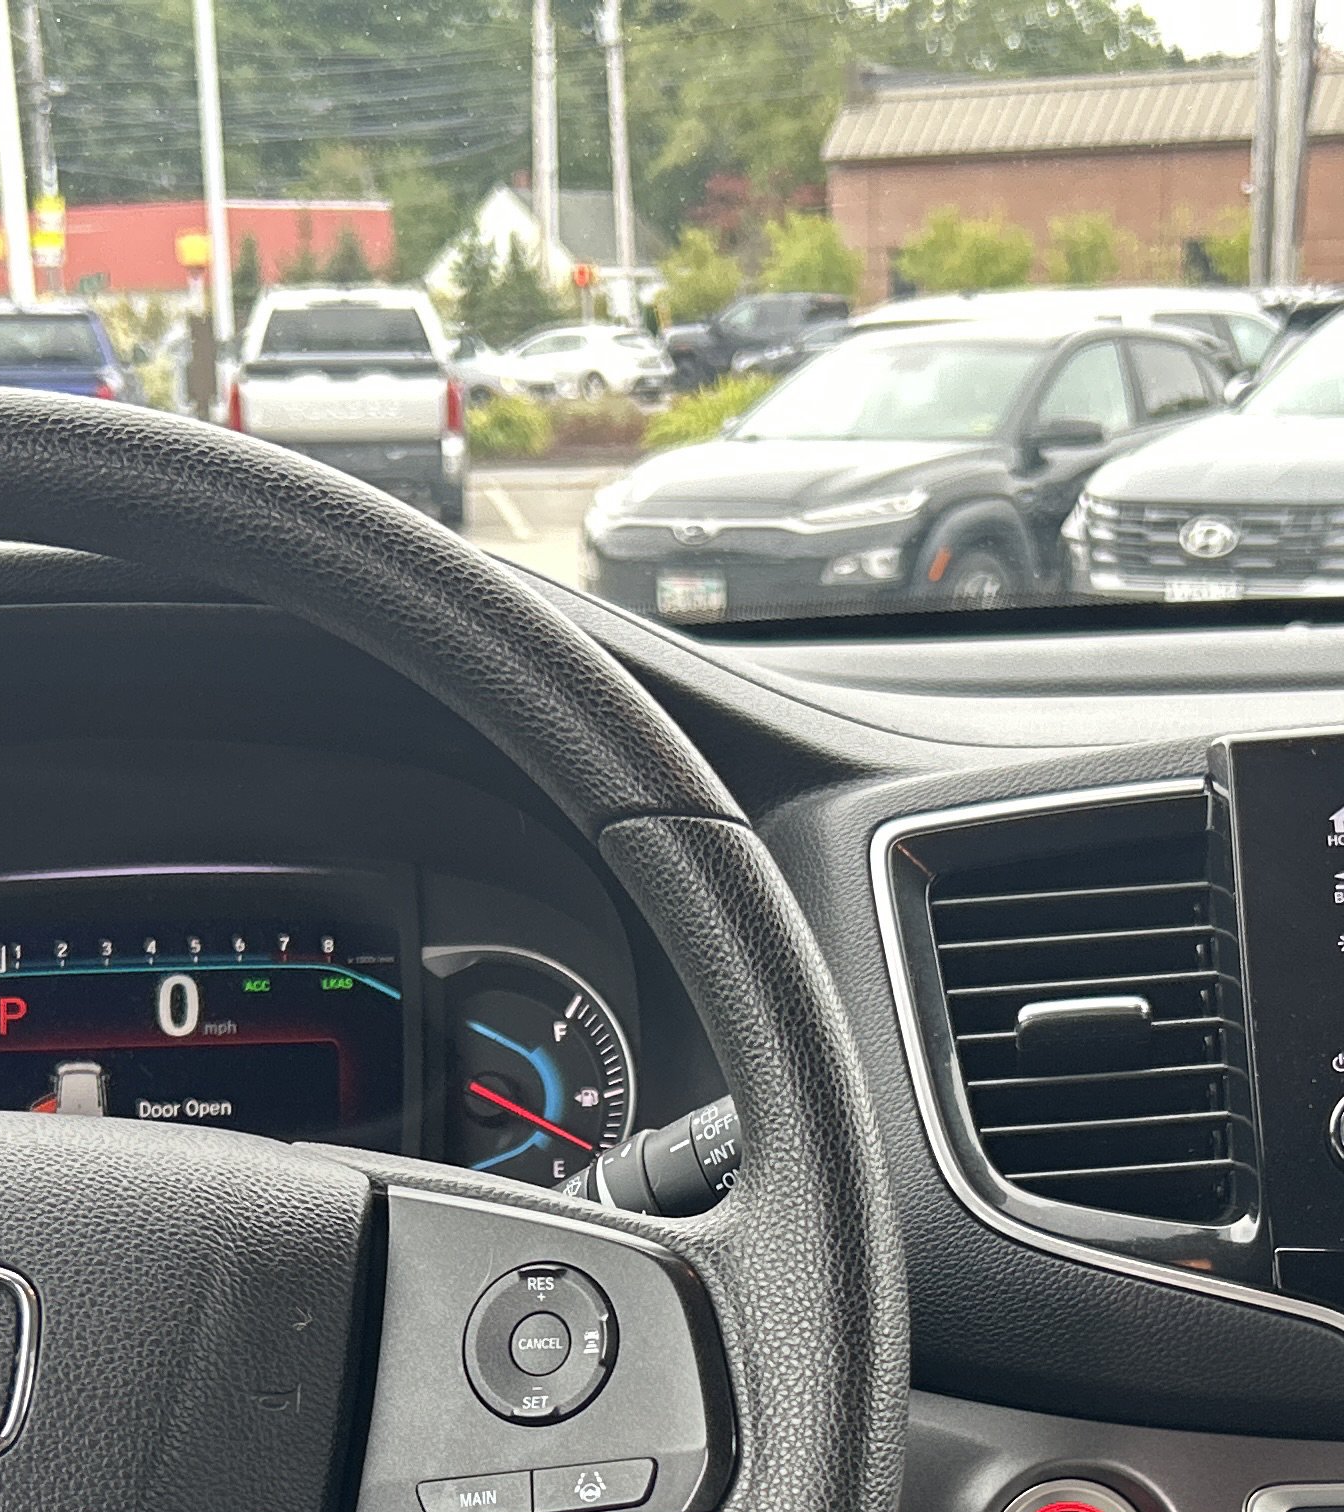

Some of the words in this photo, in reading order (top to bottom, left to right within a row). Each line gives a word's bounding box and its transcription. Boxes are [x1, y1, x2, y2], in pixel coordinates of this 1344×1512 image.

[14, 943, 23, 960] 1
[57, 941, 68, 958] 2
[102, 940, 113, 957] 3
[146, 938, 157, 955] 4
[190, 937, 202, 954] 5
[234, 936, 246, 953] 6
[279, 935, 291, 952] 7
[323, 936, 335, 954] 8
[243, 978, 271, 994] ACC
[322, 977, 354, 991] LKAS
[158, 974, 200, 1038] 0
[203, 1019, 238, 1036] mph
[554, 1021, 568, 1042] F
[138, 1100, 181, 1120] Door
[185, 1099, 232, 1120] Open
[703, 1113, 733, 1140] OFF
[709, 1138, 736, 1166] INT
[553, 1160, 565, 1179] E
[526, 1276, 555, 1291] RES
[517, 1337, 564, 1351] CANCEL
[521, 1395, 549, 1409] SET
[459, 1490, 498, 1508] MAIN
